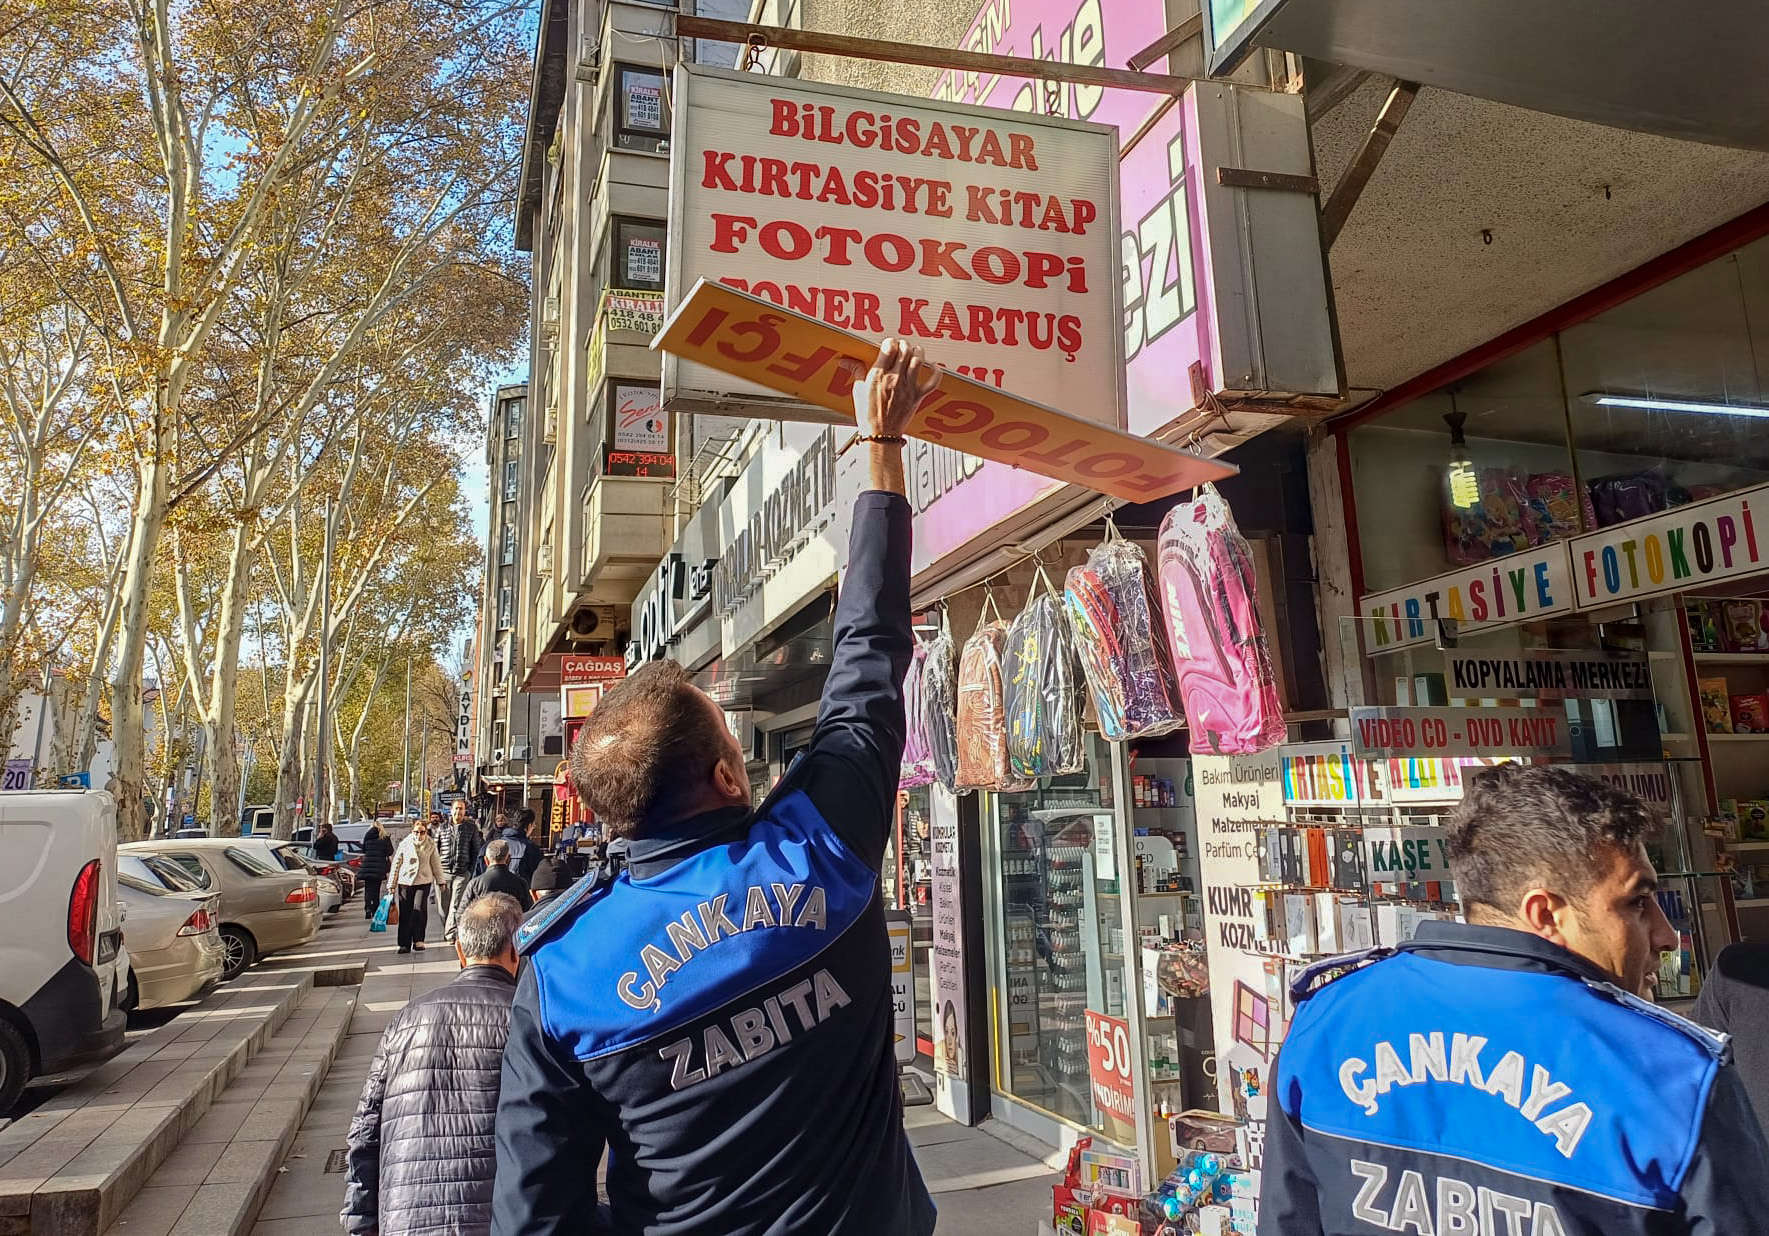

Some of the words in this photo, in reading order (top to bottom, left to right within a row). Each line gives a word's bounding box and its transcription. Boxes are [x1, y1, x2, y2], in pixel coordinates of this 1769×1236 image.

[629, 247, 659, 255] ABANT
[610, 309, 634, 319] 418
[638, 312, 654, 322] 48
[611, 318, 632, 328] 0532
[635, 321, 649, 333] 601
[898, 297, 1082, 362] KARTUŞ
[686, 305, 1184, 496] FOTOĞAFÇI
[611, 454, 635, 464] 0542
[639, 454, 657, 464] 394
[660, 455, 672, 465] 04
[636, 466, 647, 477] 14
[1584, 500, 1760, 598] FOTOKOPİ
[1371, 561, 1554, 646] KIRTASİYE
[565, 660, 622, 675] ÇAĞDAŞ
[1453, 659, 1567, 689] KOPYALAMA
[459, 692, 471, 749] AYDIN
[1421, 718, 1448, 748] CD
[1466, 718, 1504, 747] DVD
[1508, 718, 1557, 747] KAYIT
[5, 771, 25, 790] 20
[1202, 769, 1232, 785] Bakım
[1235, 762, 1279, 782] Ürünleri
[1282, 745, 1383, 800] KIRTASİYE
[1222, 790, 1260, 810] Makyaj
[1205, 842, 1241, 858] Parfüm
[1244, 842, 1260, 861] Çe
[1371, 839, 1432, 880] KAŞE
[1208, 886, 1254, 918] KUMR
[617, 883, 827, 1015] ÇANKAYA
[659, 968, 851, 1091] ZABITA
[1338, 1031, 1594, 1159] ÇANKAYA
[1350, 1158, 1567, 1236] ZABITA
